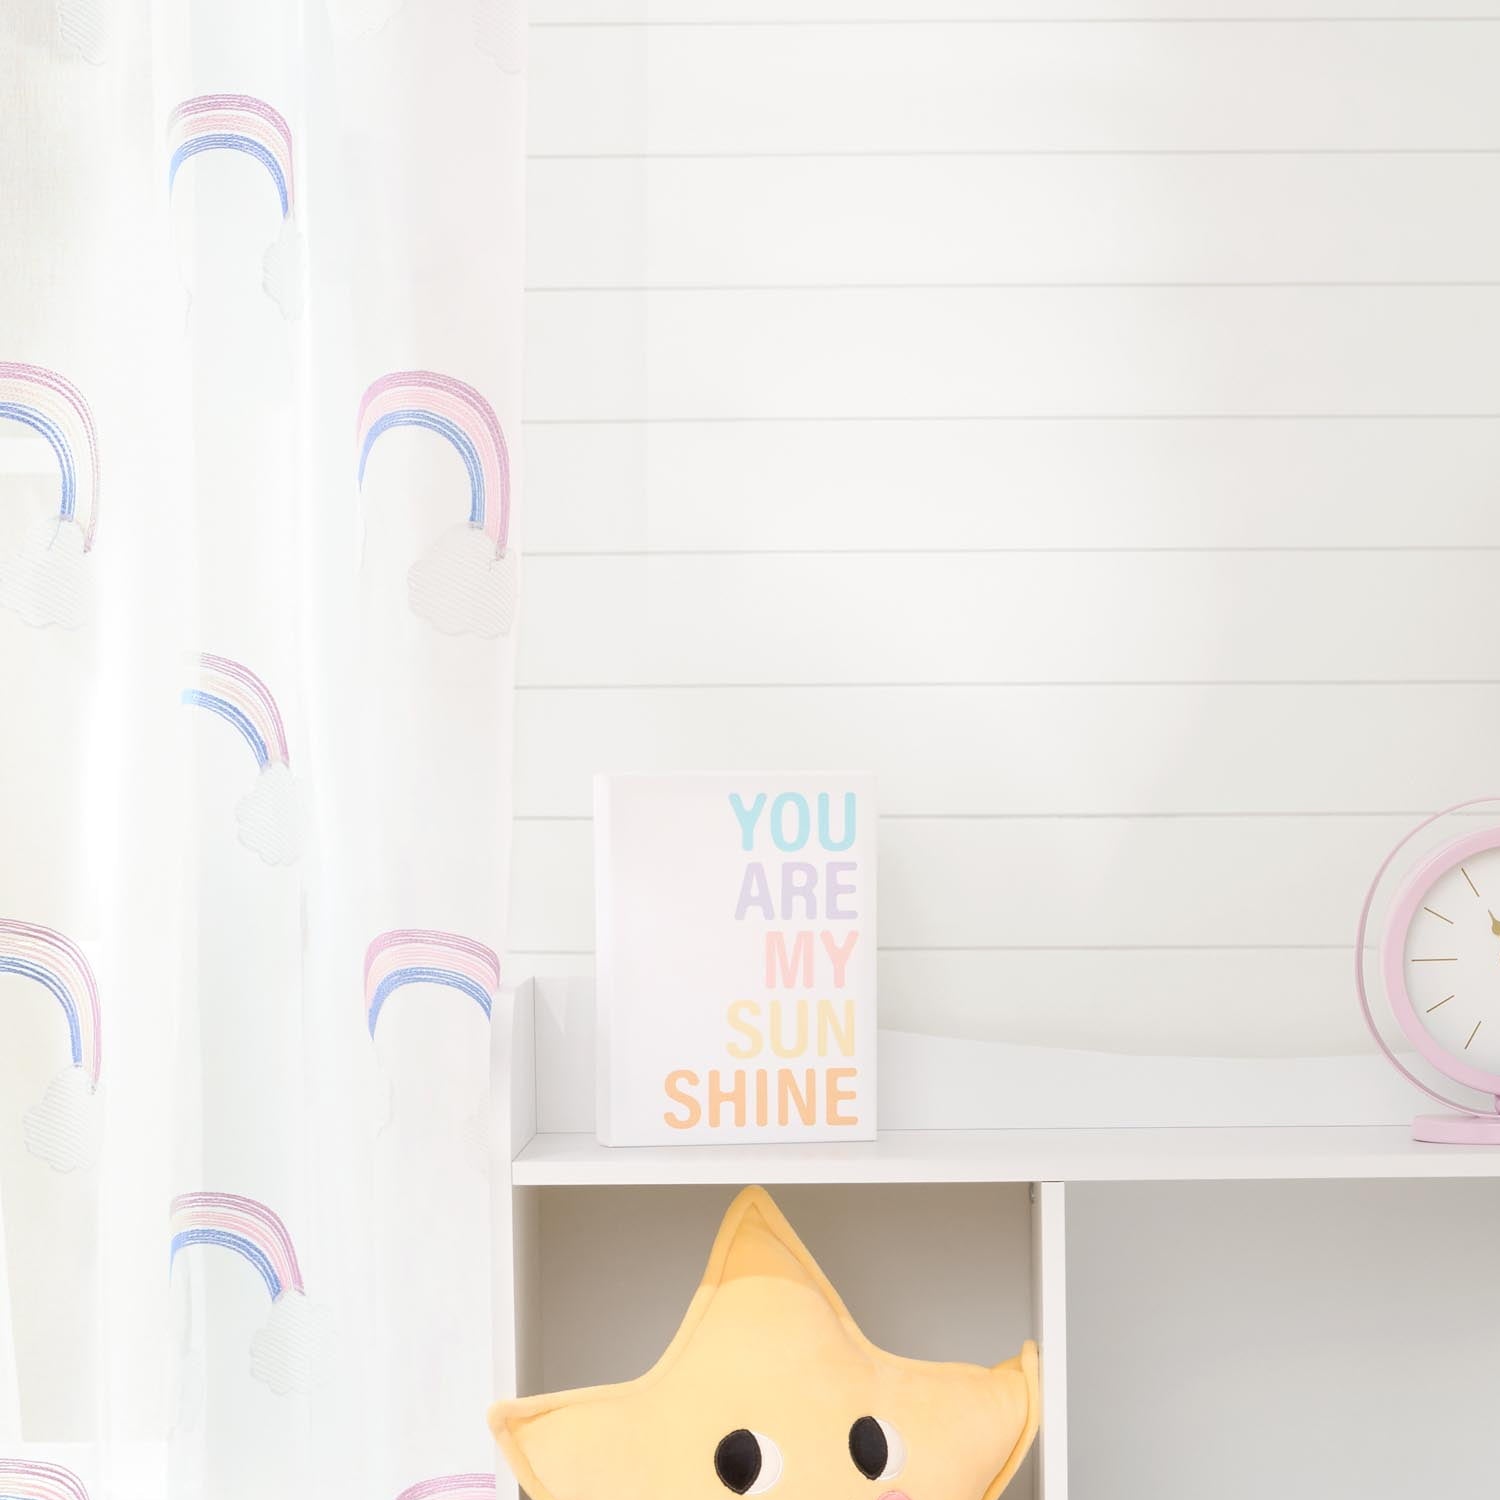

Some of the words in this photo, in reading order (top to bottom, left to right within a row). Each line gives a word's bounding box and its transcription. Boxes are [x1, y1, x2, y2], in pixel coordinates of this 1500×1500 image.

[729, 792, 856, 852] YOU
[734, 862, 858, 920] ARE
[765, 930, 860, 989] MY
[725, 999, 855, 1059] SUN
[663, 1067, 859, 1129] SHINE
